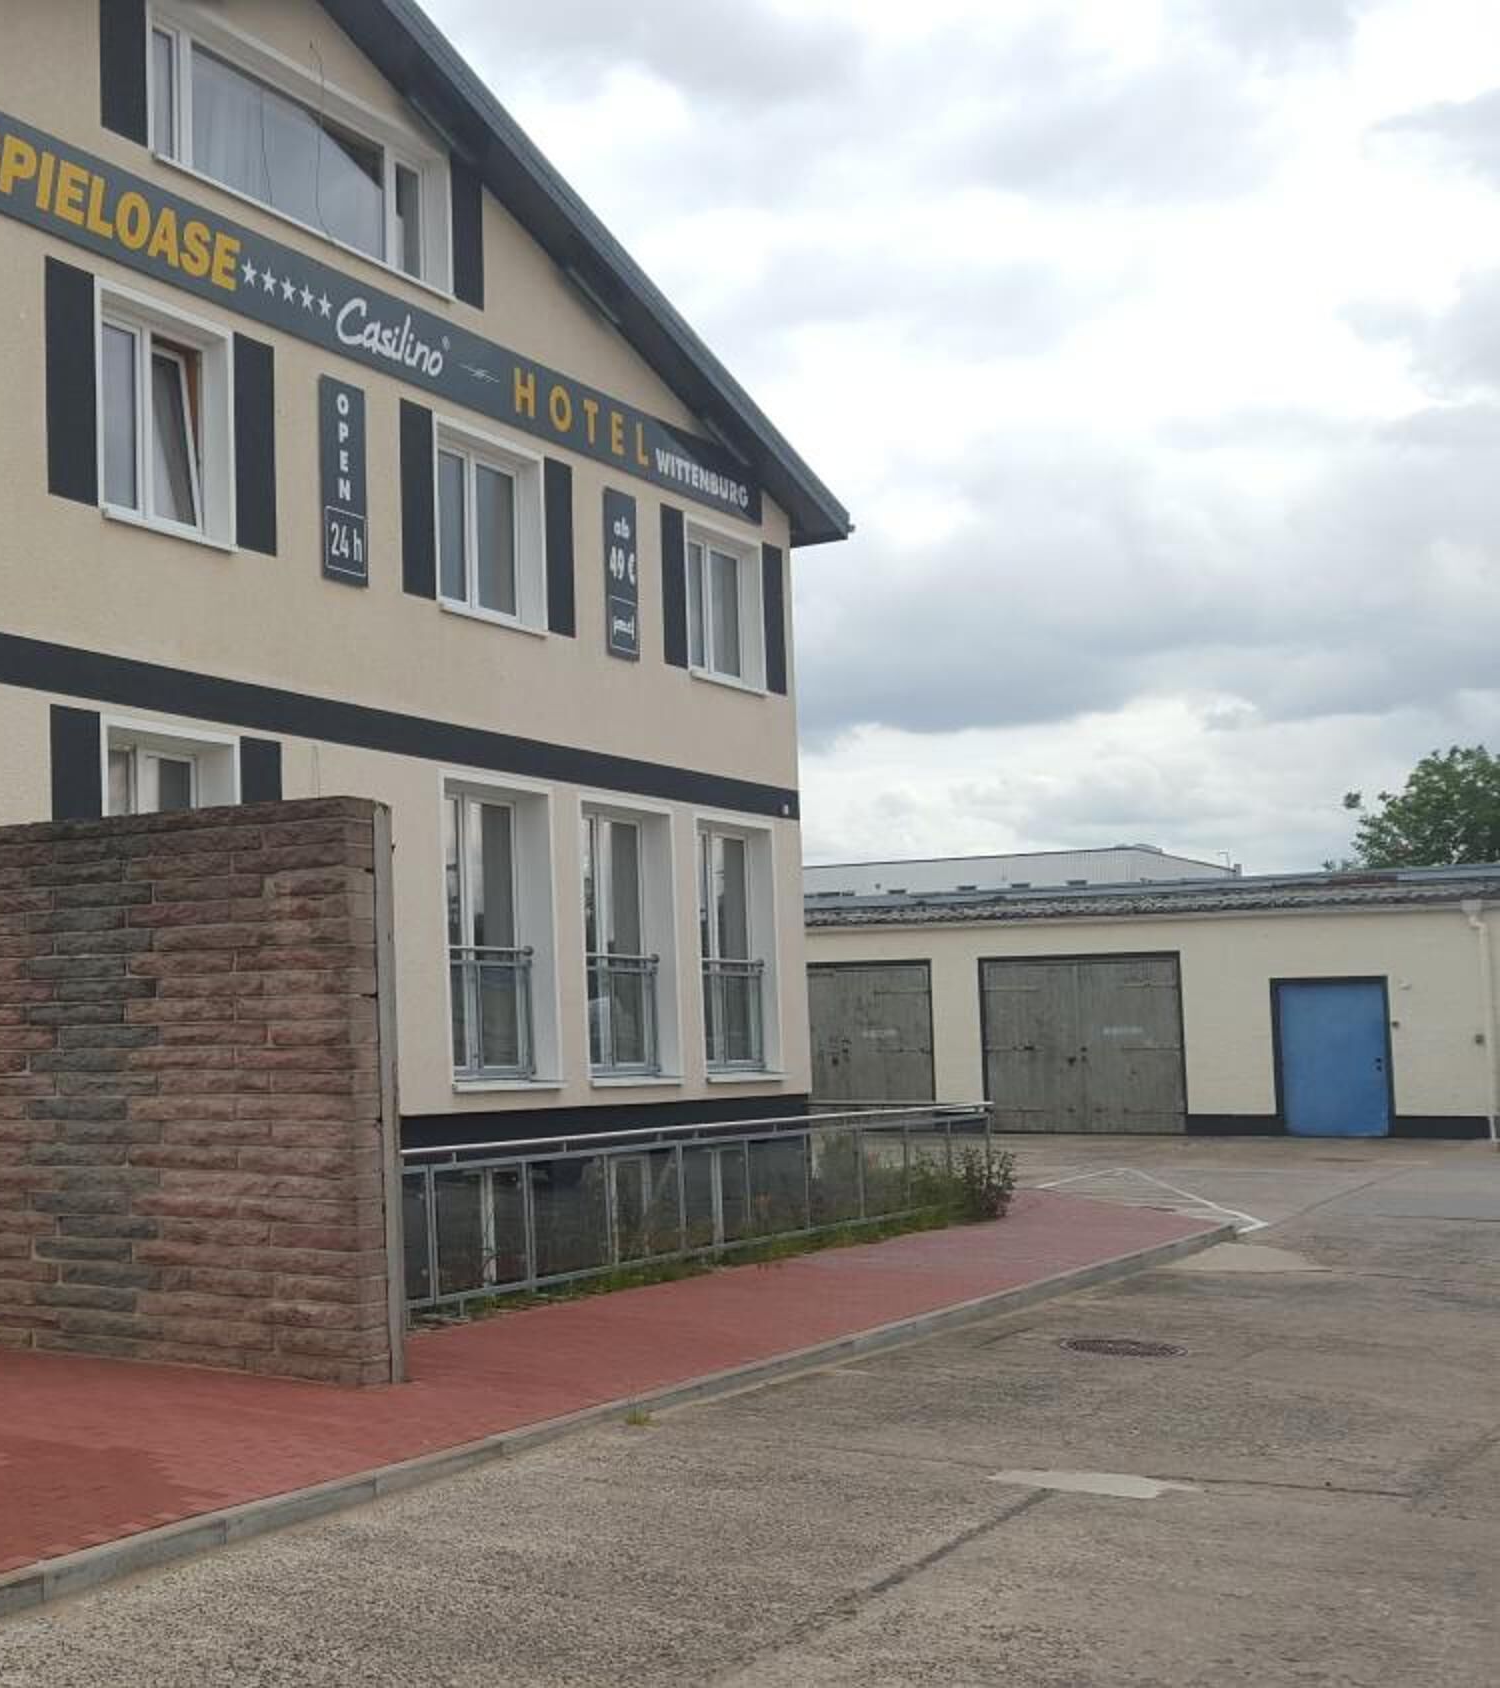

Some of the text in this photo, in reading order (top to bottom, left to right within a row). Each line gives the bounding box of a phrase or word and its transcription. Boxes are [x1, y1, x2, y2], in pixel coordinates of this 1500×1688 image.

[336, 298, 443, 376] Casilino
[514, 367, 648, 466] HOTEL
[655, 447, 748, 507] WITTENBURG
[336, 393, 351, 501] OPEN
[330, 521, 363, 563] 24 h
[613, 516, 630, 539] ab
[609, 546, 625, 580] 49
